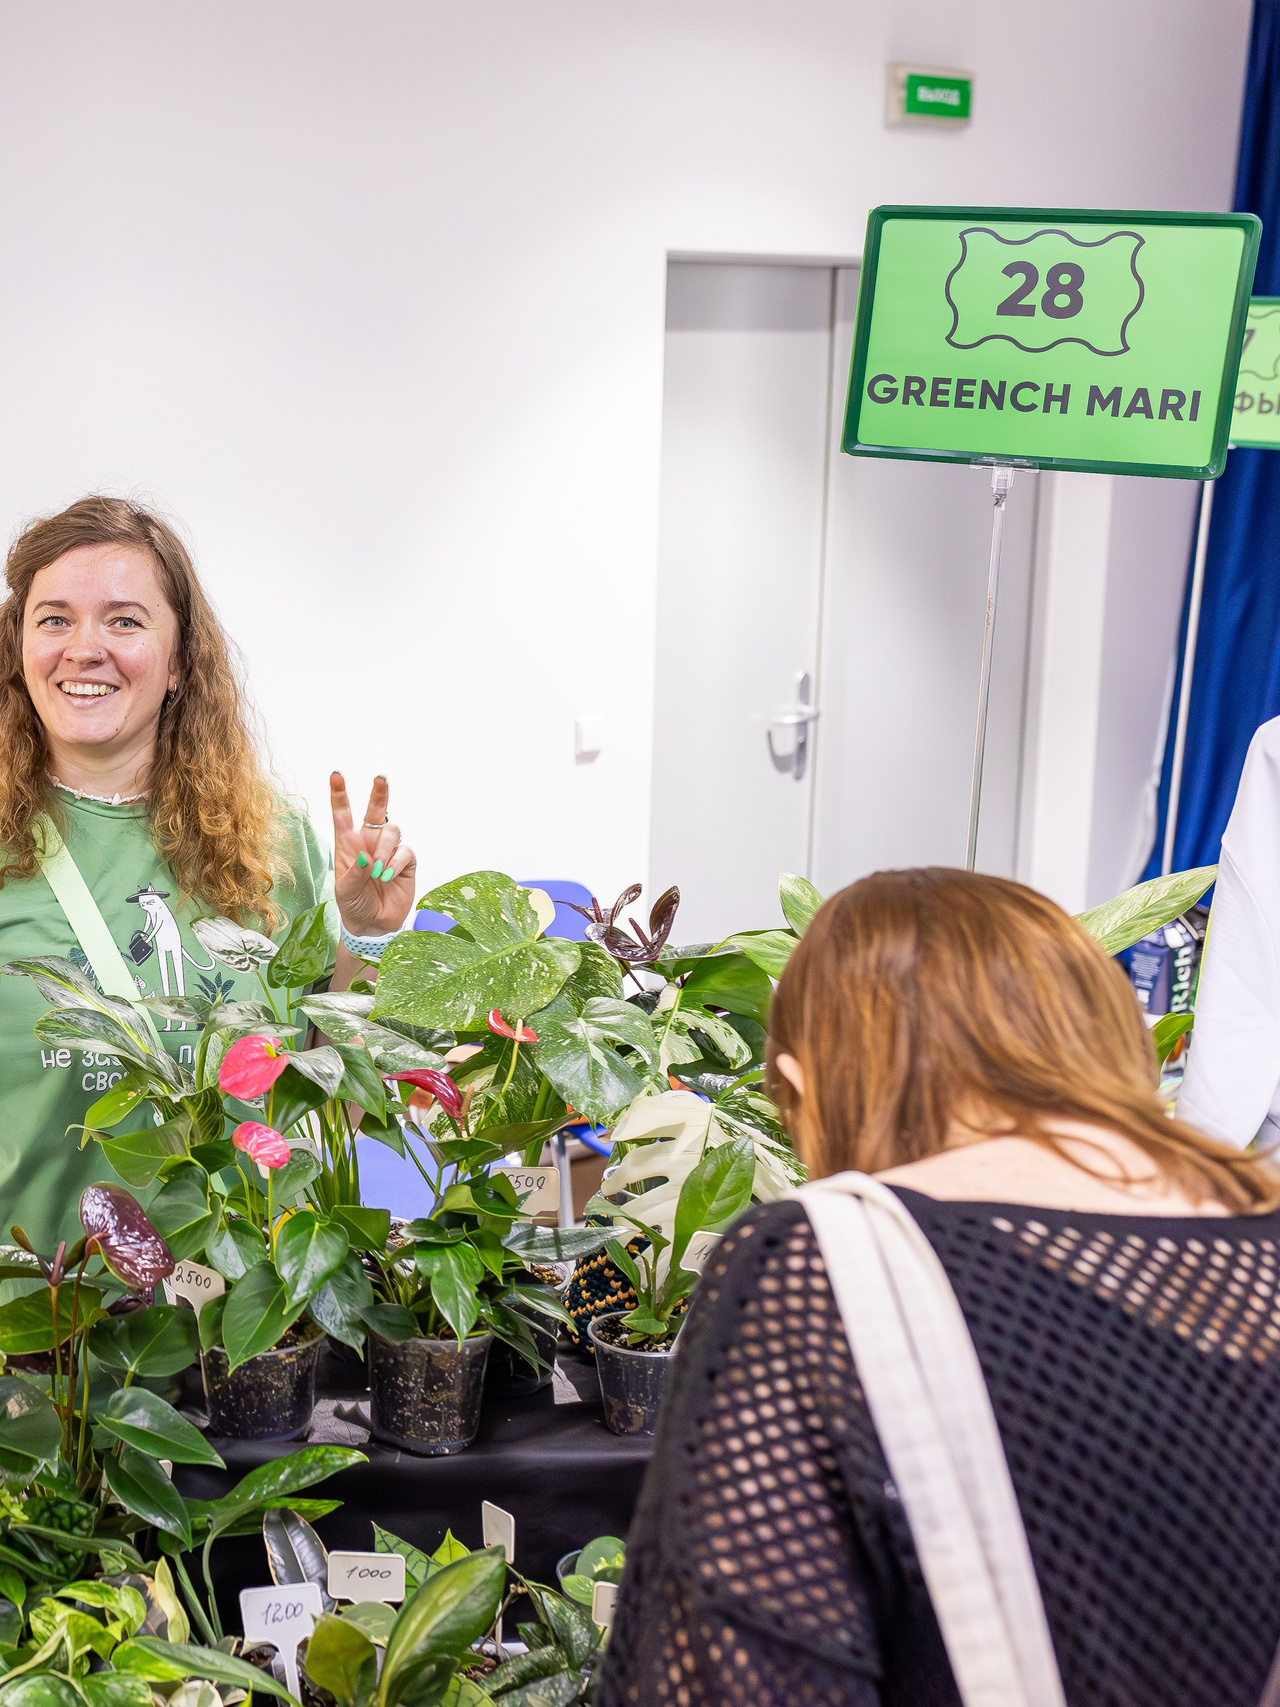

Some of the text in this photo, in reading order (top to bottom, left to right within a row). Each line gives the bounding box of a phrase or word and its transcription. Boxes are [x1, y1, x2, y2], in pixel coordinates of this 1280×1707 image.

[996, 261, 1085, 319] 28
[867, 373, 1202, 422] GREENCH MARI
[1171, 946, 1193, 1013] Rich
[40, 1048, 72, 1069] не
[81, 1071, 128, 1092] сво
[176, 1265, 212, 1289] 2500
[346, 1565, 392, 1579] 1000
[262, 1602, 304, 1626] 1200
